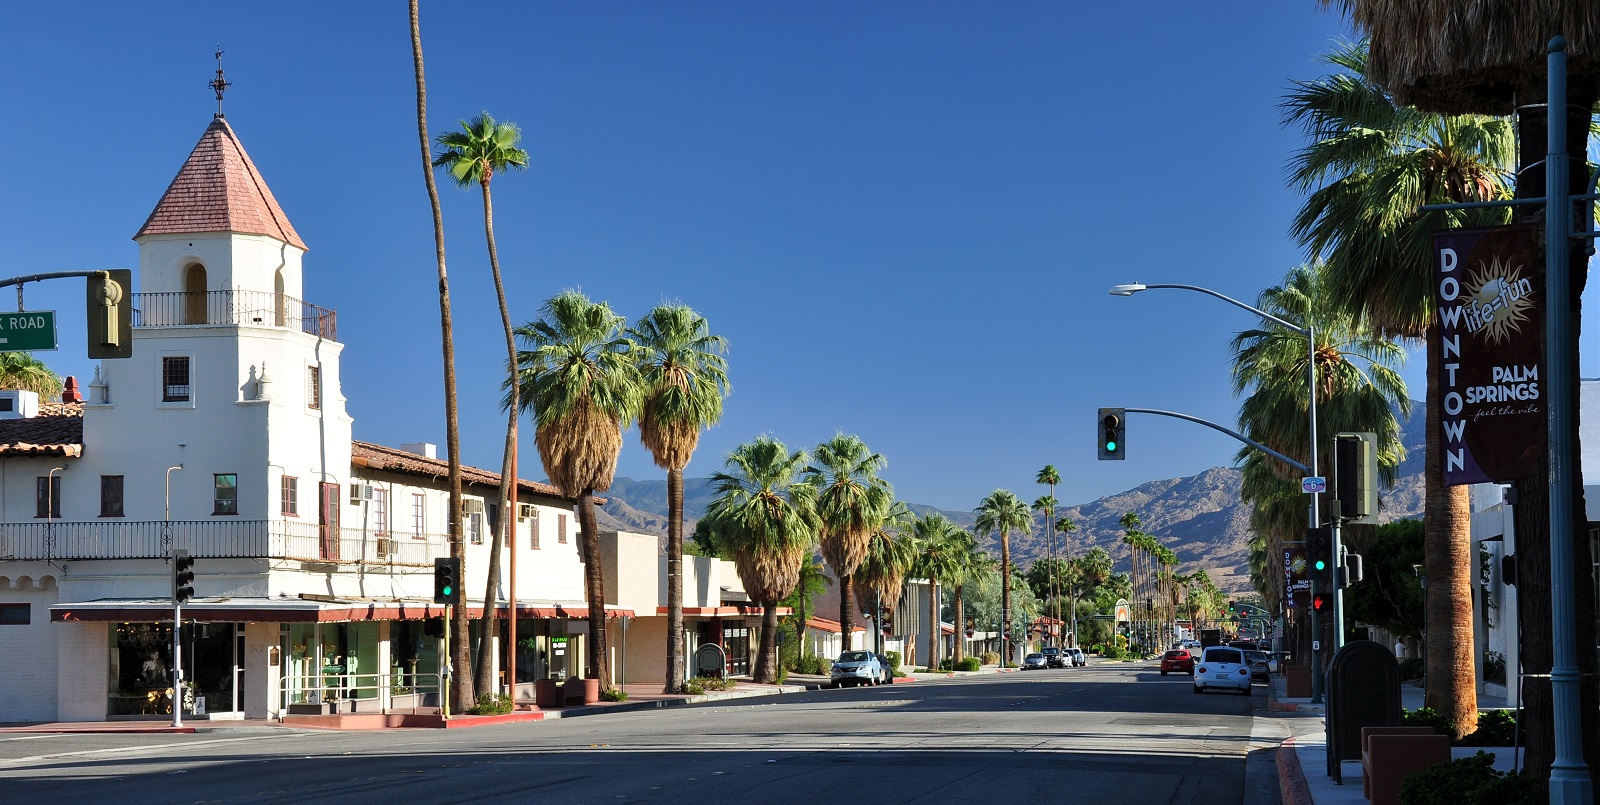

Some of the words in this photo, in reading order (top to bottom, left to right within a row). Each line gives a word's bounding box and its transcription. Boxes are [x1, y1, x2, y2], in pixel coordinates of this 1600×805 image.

[1461, 275, 1533, 334] life=fun
[10, 316, 45, 329] ROAD
[1439, 248, 1466, 472] DOWNTOWN
[1492, 364, 1539, 384] PALM
[1465, 382, 1540, 404] SPRINGS
[1498, 405, 1516, 416] the
[1517, 403, 1540, 415] vibe
[1311, 480, 1316, 489] 6
[1285, 552, 1294, 606] DOWNTOWN
